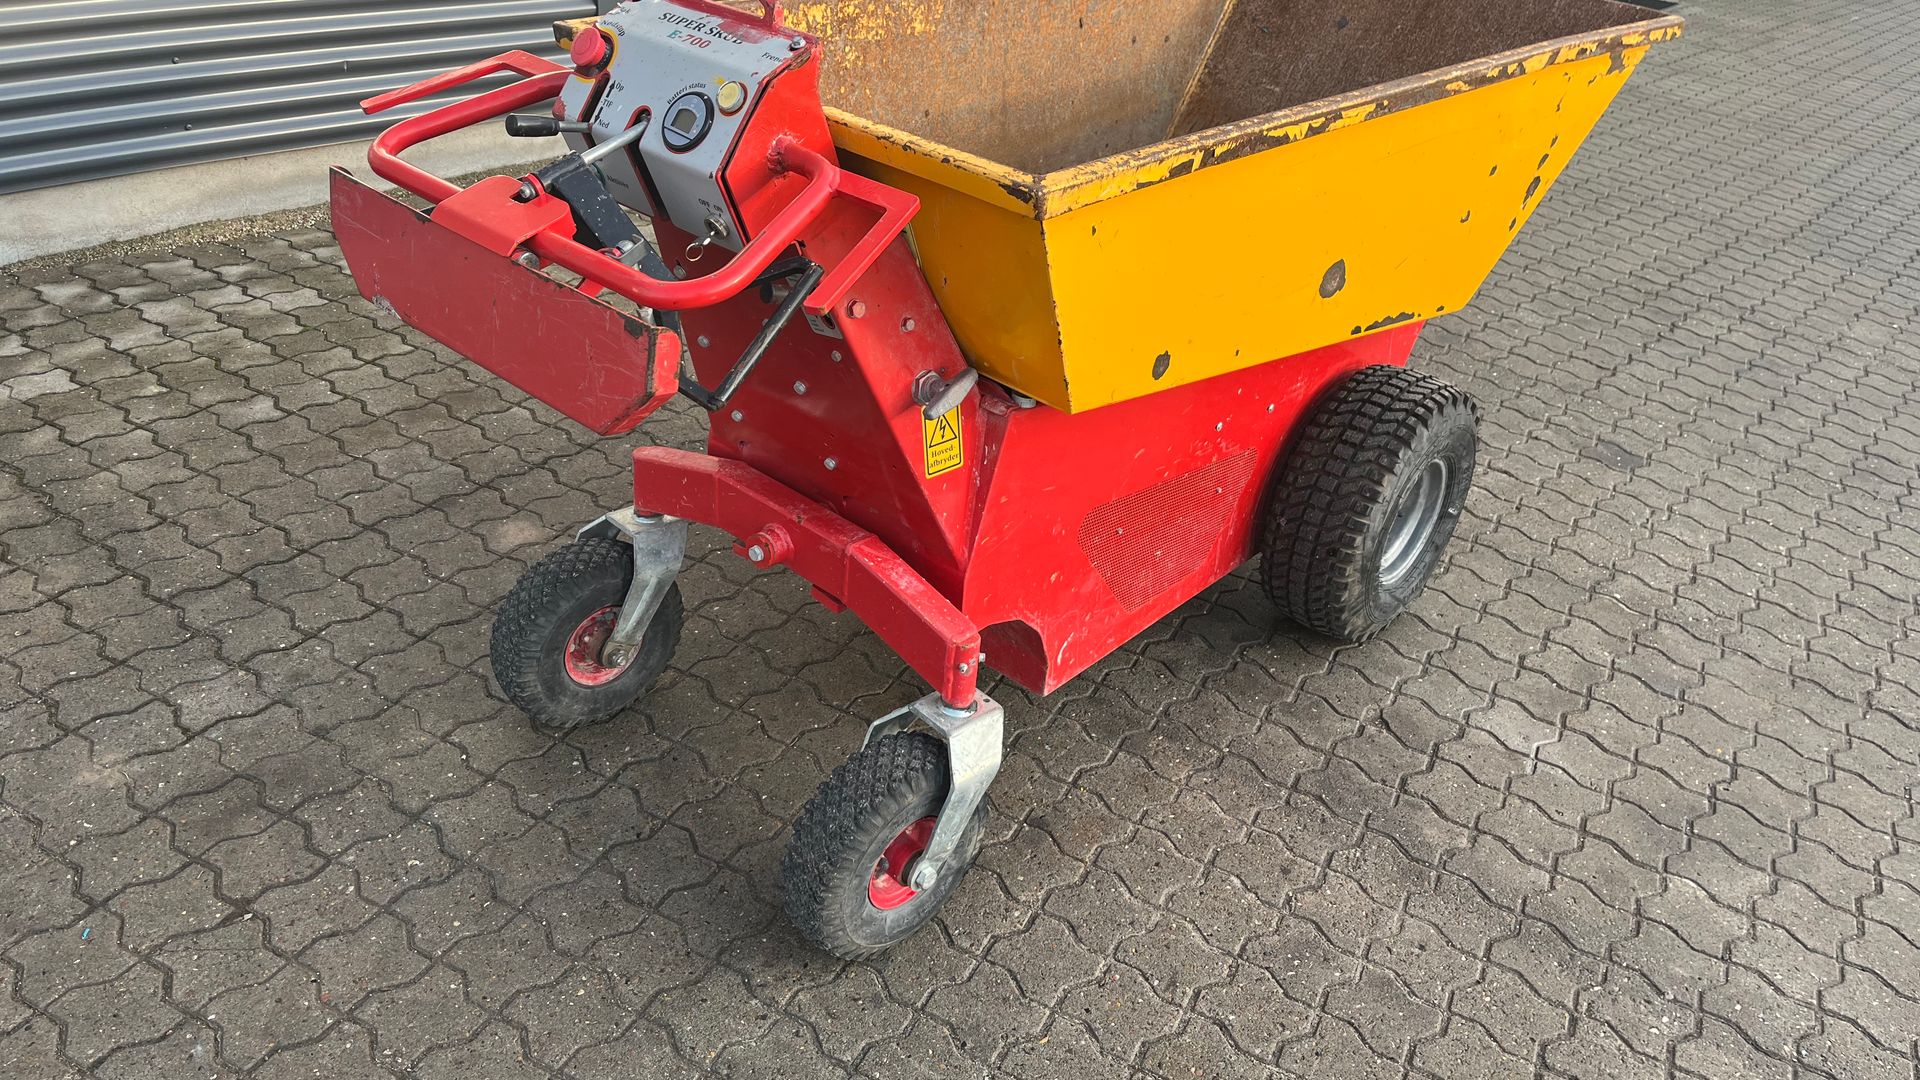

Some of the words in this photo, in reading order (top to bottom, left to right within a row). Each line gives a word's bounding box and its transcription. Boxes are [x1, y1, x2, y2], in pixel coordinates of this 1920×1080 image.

[658, 12, 706, 32] SUPER
[667, 29, 712, 49] E-700
[615, 81, 625, 93] Op
[666, 85, 688, 105] Batteri
[931, 444, 956, 458] Hoved-
[929, 453, 959, 468] afbryder
